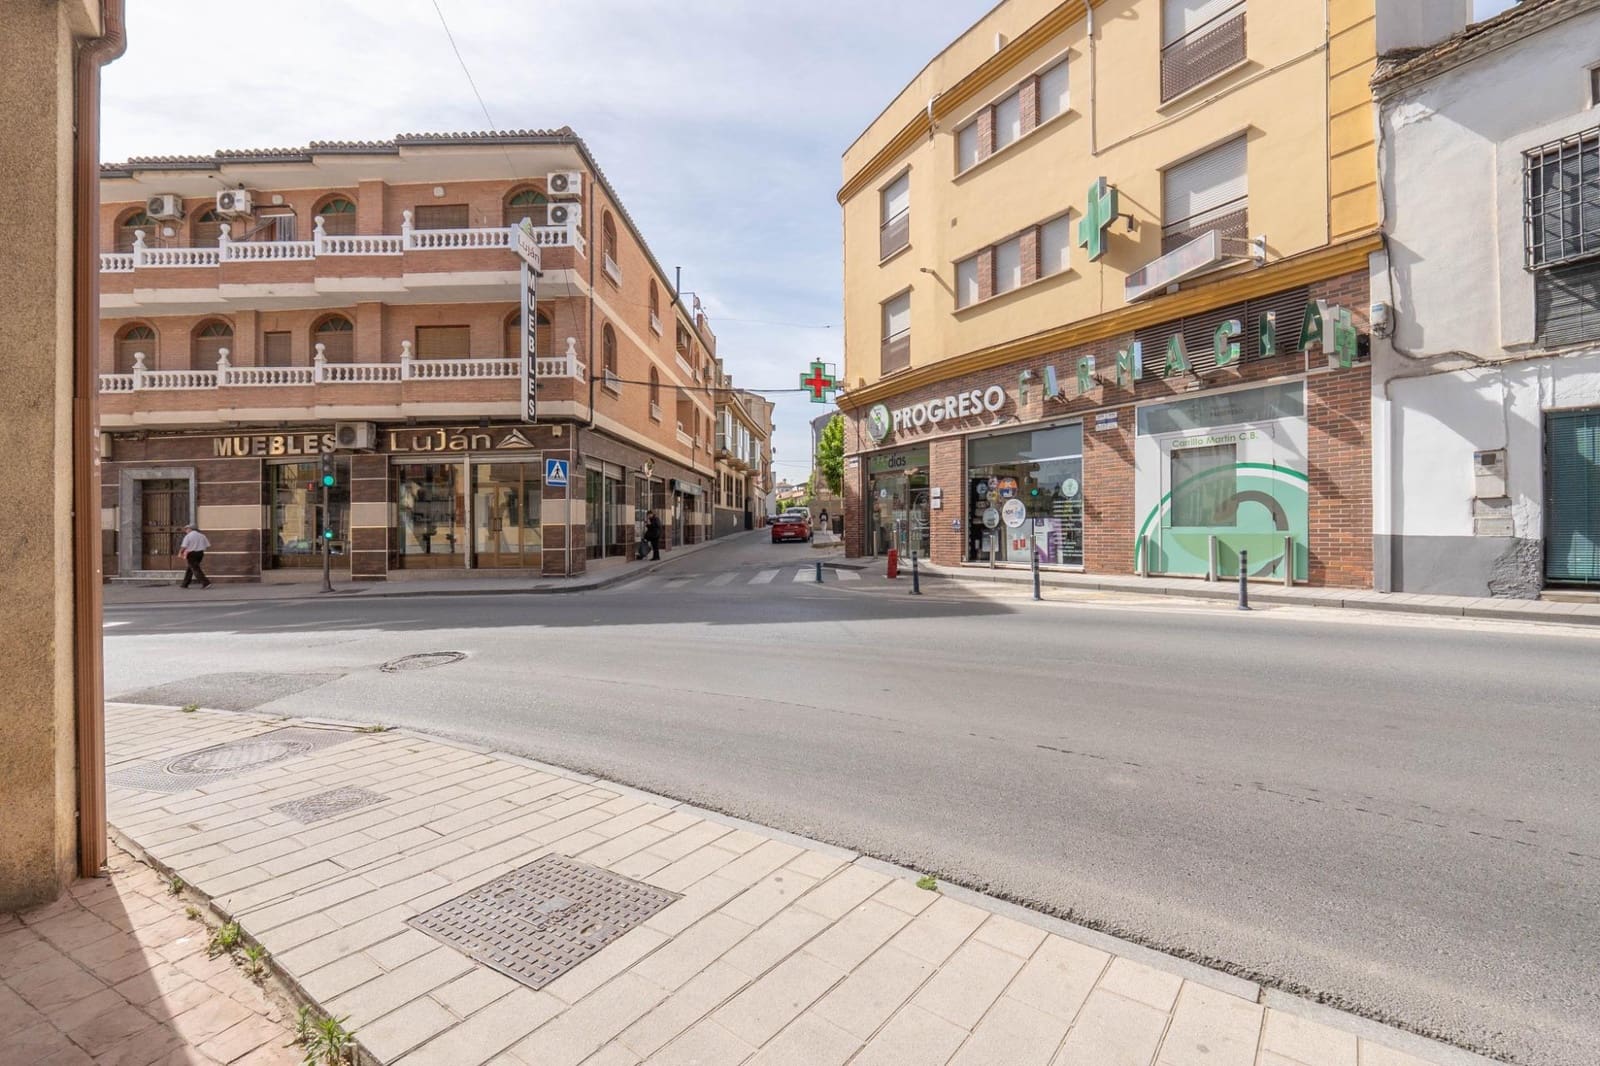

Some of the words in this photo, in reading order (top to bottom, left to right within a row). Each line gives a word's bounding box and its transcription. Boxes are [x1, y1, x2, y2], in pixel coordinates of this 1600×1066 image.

[528, 270, 536, 416] MUEBLES
[1018, 299, 1336, 407] FARMACIA
[213, 433, 337, 457] MUEBLES
[892, 385, 1006, 431] PROGRESO
